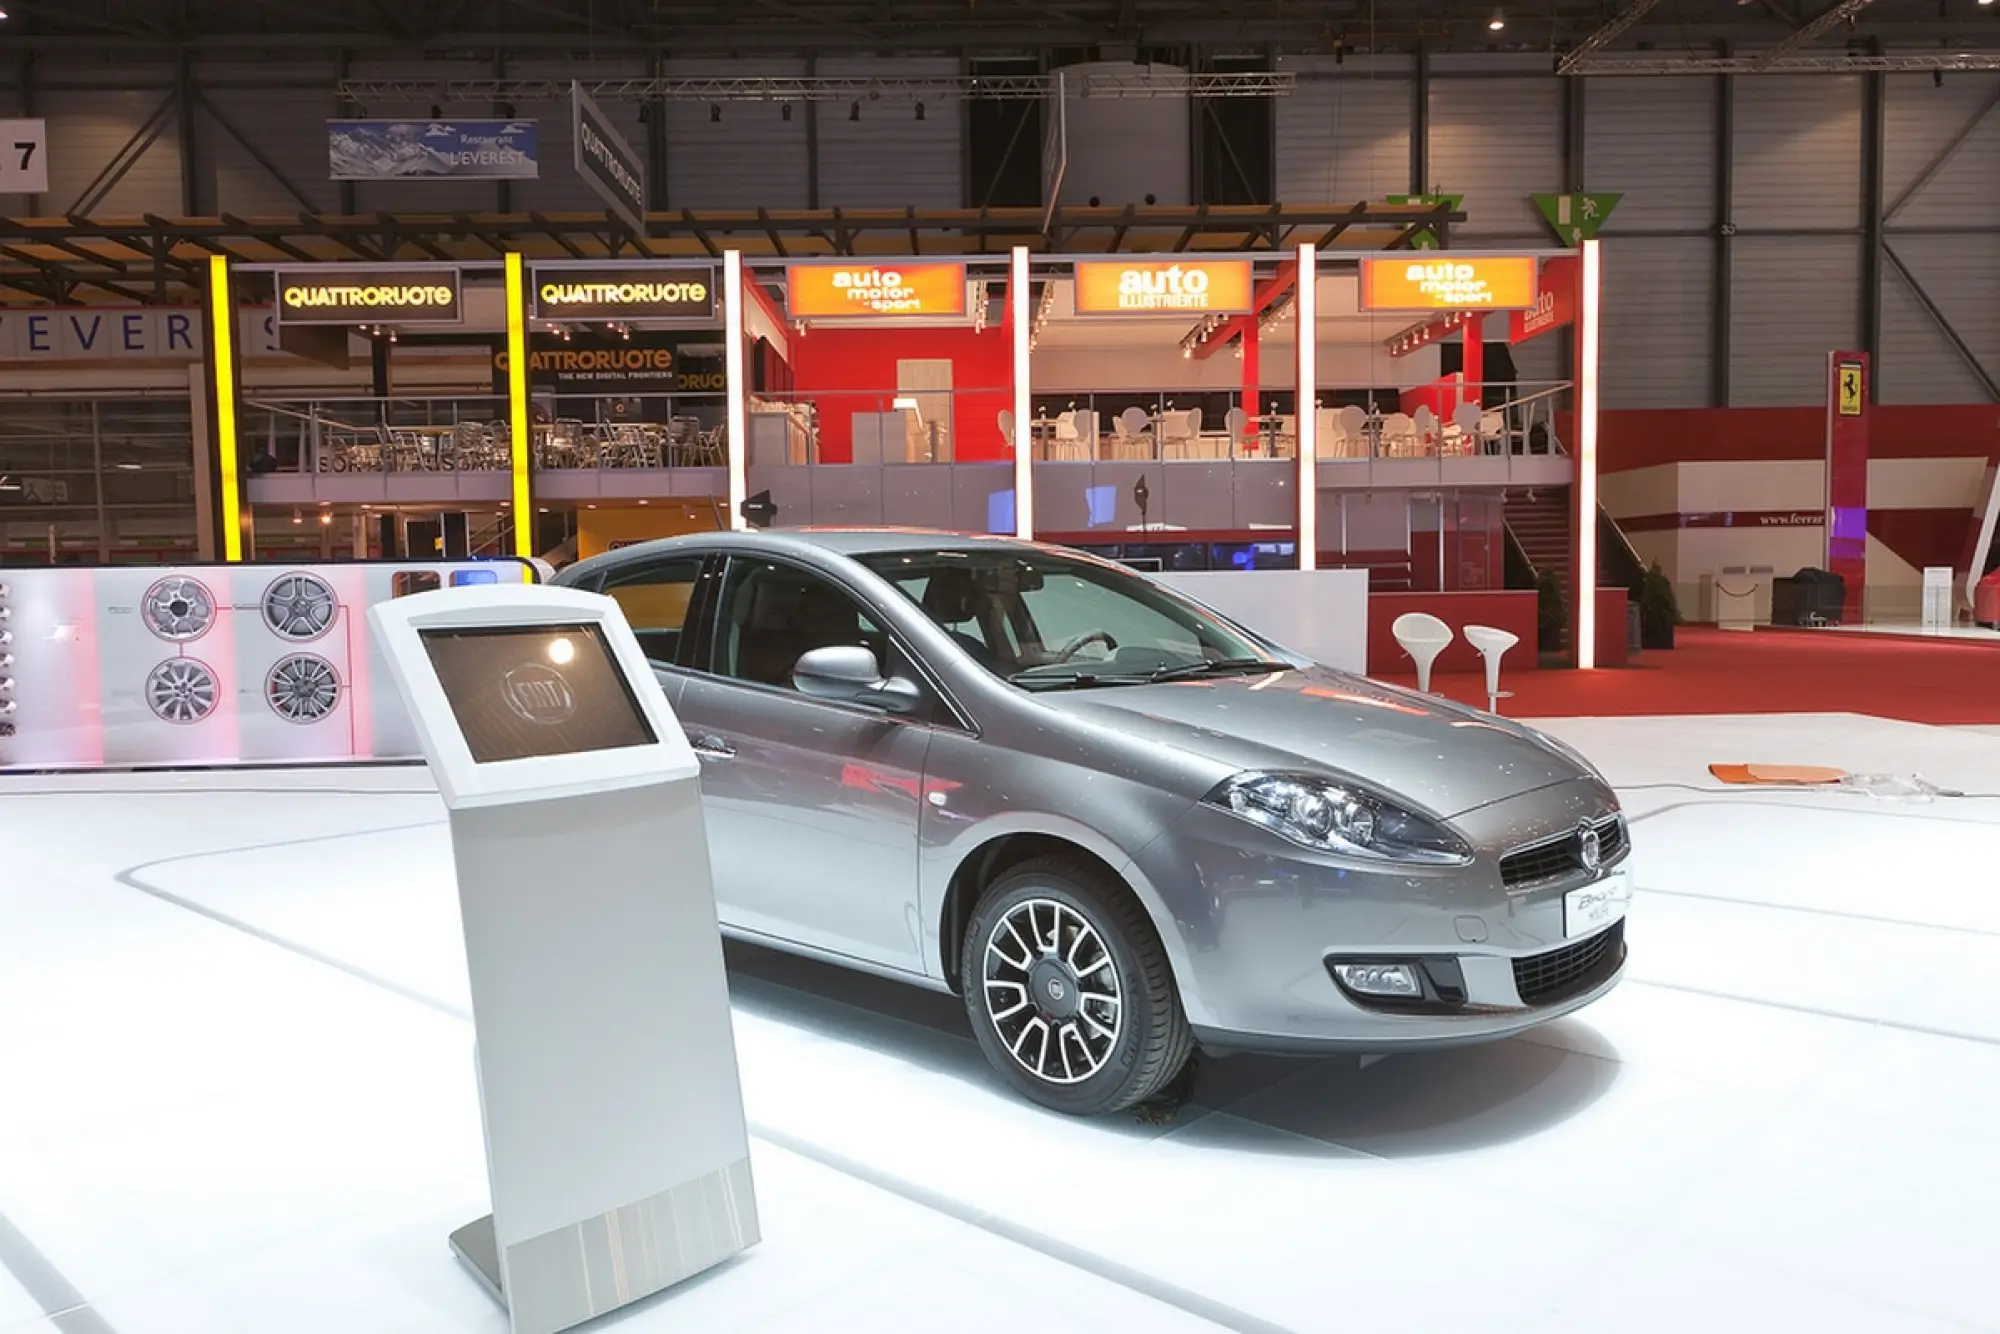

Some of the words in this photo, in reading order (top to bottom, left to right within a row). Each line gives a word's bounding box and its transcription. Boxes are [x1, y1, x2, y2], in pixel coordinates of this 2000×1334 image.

[14, 141, 36, 171] 7
[449, 151, 526, 166] L'EVEREST
[832, 270, 902, 288] auto
[1119, 264, 1209, 294] auto
[1406, 263, 1475, 281] auto
[847, 287, 914, 299] motor
[1420, 280, 1487, 293] motor
